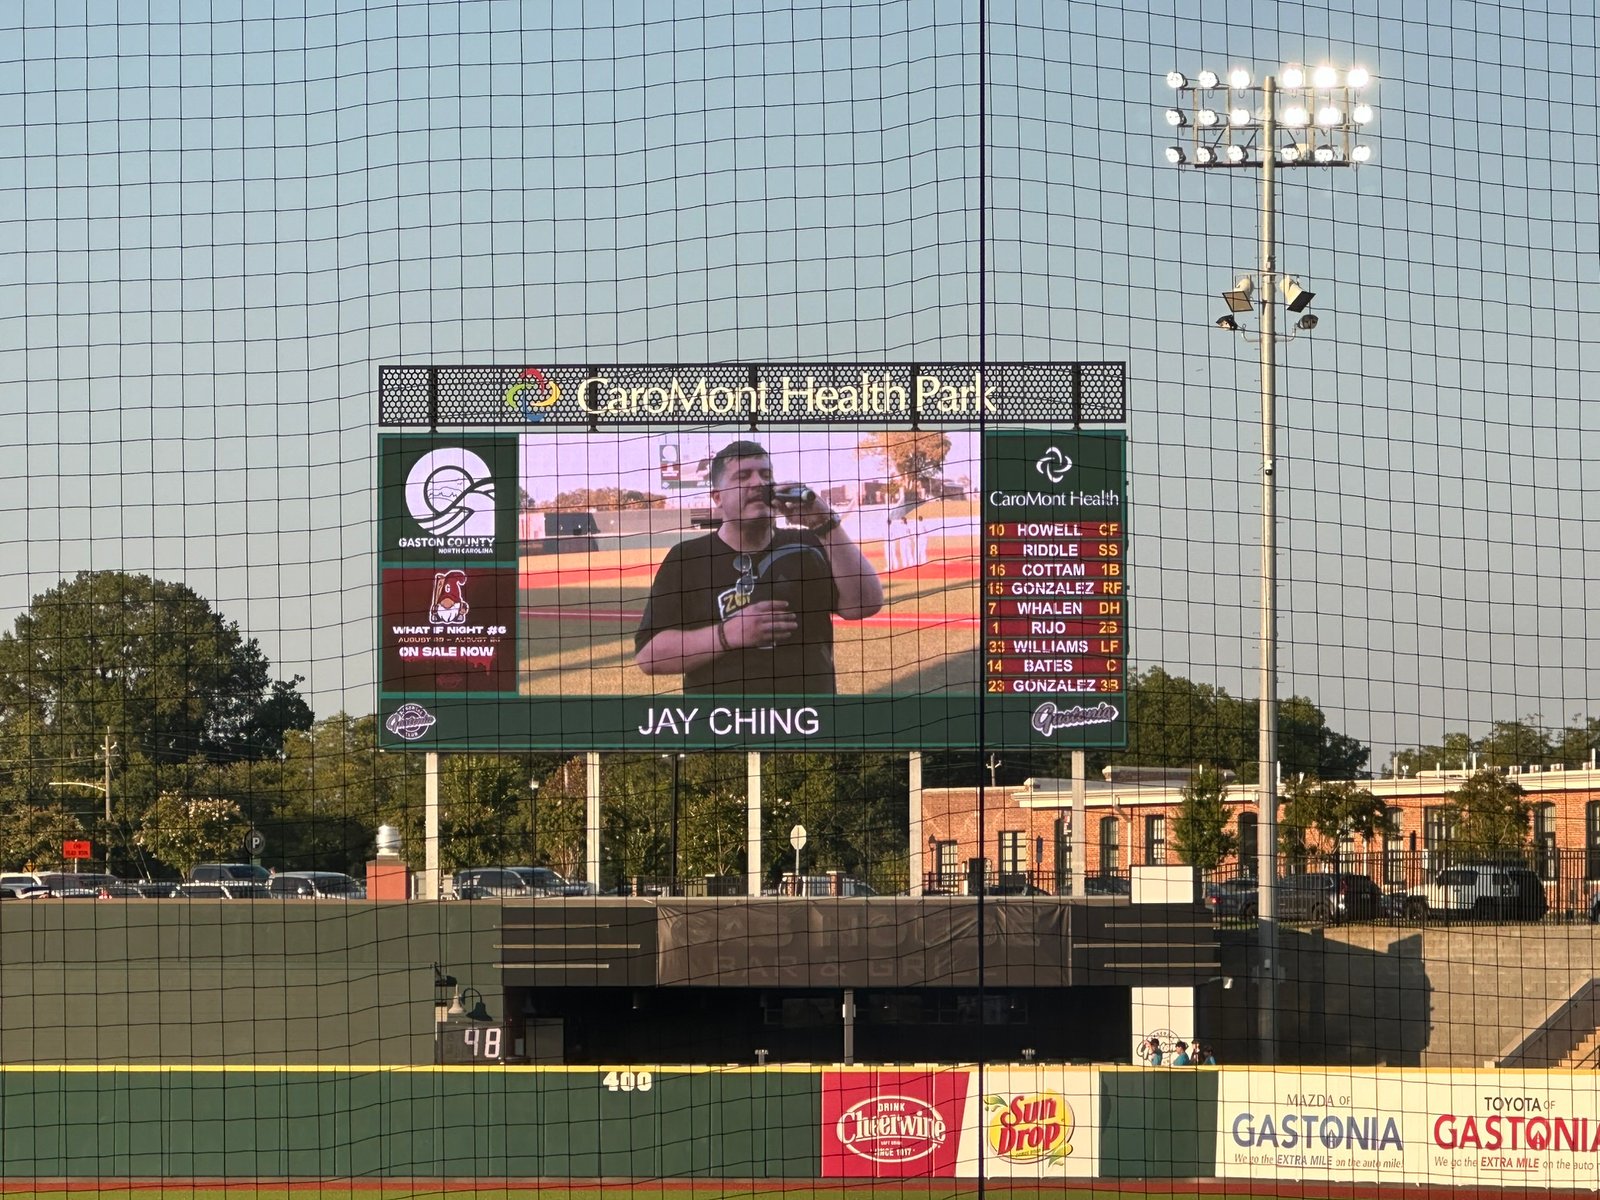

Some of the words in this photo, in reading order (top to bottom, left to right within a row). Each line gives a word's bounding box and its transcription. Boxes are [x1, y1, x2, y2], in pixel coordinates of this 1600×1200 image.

[577, 376, 772, 414] CaroMont
[782, 371, 906, 414] Health
[916, 370, 997, 414] Park
[990, 490, 1067, 506] CaroMont
[1070, 490, 1119, 506] Health
[988, 524, 1005, 536] 10
[1017, 524, 1083, 536] HOWELL
[1099, 523, 1118, 536] CF
[398, 537, 444, 547] GASTON
[447, 537, 495, 548] COUNTY
[990, 544, 998, 556] 8
[1023, 544, 1078, 556] RIDDLE
[1098, 544, 1118, 556] SS
[990, 564, 1006, 576] 16
[1022, 564, 1085, 576] COTTAM
[1101, 564, 1120, 576] 1B
[444, 583, 451, 593] G
[988, 582, 1003, 594] 15
[1012, 582, 1094, 594] GONZALEZ
[1103, 582, 1122, 594] RF
[988, 603, 996, 614] 7
[1017, 602, 1082, 614] WHALEN
[1099, 602, 1120, 614] DH
[392, 626, 430, 634] WHAT
[433, 626, 444, 634] IF
[447, 626, 484, 634] NIGHT
[487, 626, 507, 635] #6
[993, 622, 999, 634] 1
[1031, 622, 1066, 634] RIJO
[1099, 622, 1118, 634] 2B
[399, 646, 419, 657] ON
[422, 646, 457, 657] SALE
[460, 646, 495, 657] NOW
[989, 641, 1005, 653] 33
[1013, 640, 1088, 653] WILLIAMS
[1101, 641, 1118, 652] LF
[987, 660, 1002, 672] 14
[1024, 660, 1073, 672] BATES
[1107, 660, 1116, 672] C
[988, 681, 1005, 692] 23
[1013, 680, 1096, 692] GONZALEZ
[1100, 680, 1118, 692] 3B
[638, 707, 699, 735] JAY
[709, 707, 820, 735] CHING
[1032, 702, 1119, 737] Gastonia
[252, 837, 259, 849] P
[713, 956, 798, 978] BAR
[603, 1071, 652, 1091] 400
[1287, 1094, 1335, 1107] MAZDA
[1339, 1096, 1351, 1105] OF
[1484, 1097, 1541, 1112] TOYOTA
[1543, 1100, 1556, 1110] OF
[877, 1103, 905, 1112] DRINK
[1000, 1095, 1057, 1128] Sun
[837, 1110, 946, 1144] Cheerwine
[1232, 1113, 1404, 1151] GASTONIA
[997, 1123, 1061, 1155] Drop
[1234, 1154, 1248, 1164] We
[1250, 1156, 1259, 1166] go
[1261, 1154, 1274, 1164] the
[1277, 1154, 1307, 1166] EXTRA
[1310, 1155, 1333, 1166] MILE
[1336, 1159, 1346, 1167] on
[1348, 1156, 1361, 1167] the
[1363, 1158, 1381, 1168] auto
[1434, 1156, 1448, 1167] We
[1451, 1158, 1462, 1169] go
[1464, 1156, 1477, 1167] the
[1480, 1157, 1513, 1168] EXTRA
[1516, 1157, 1540, 1168] MILE
[1542, 1161, 1554, 1169] on
[1557, 1158, 1571, 1170] the
[1573, 1160, 1594, 1171] auto
